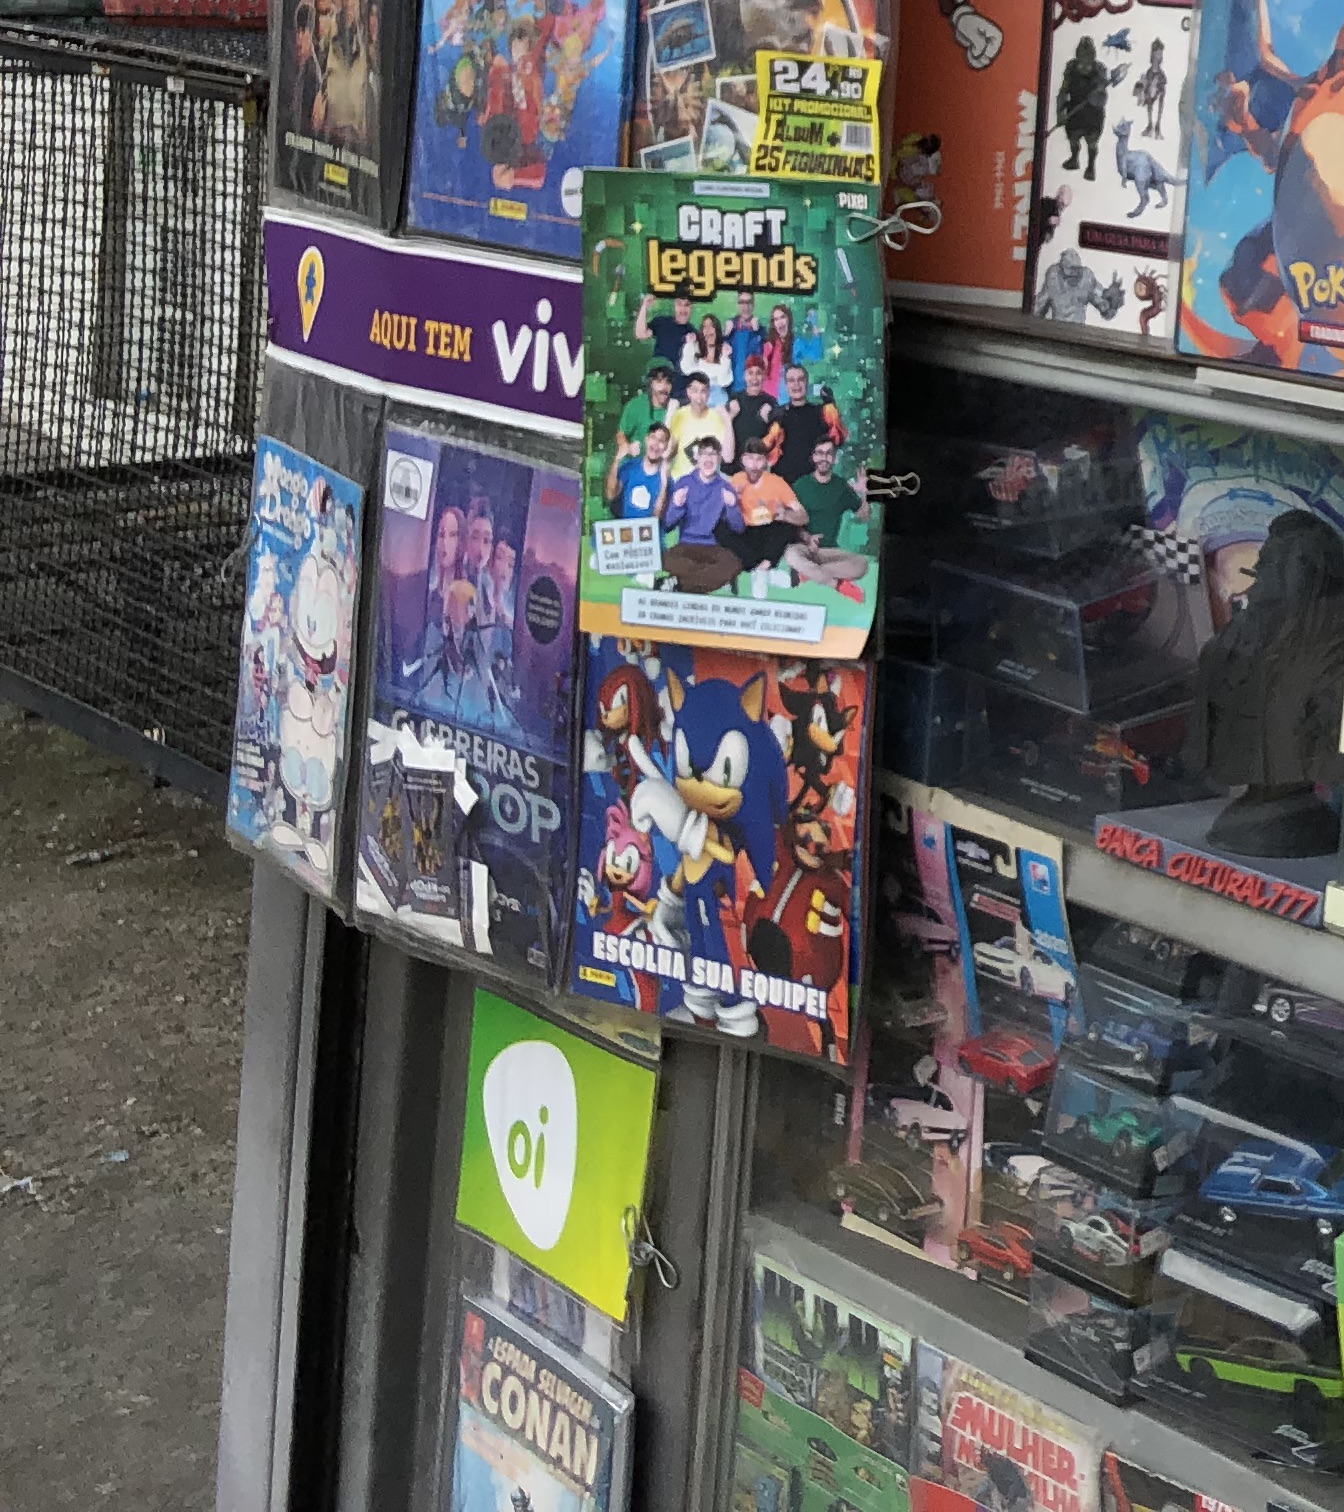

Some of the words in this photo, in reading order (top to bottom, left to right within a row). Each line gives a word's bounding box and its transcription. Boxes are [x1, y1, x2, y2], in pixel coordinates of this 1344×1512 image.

[756, 145, 782, 172] 25
[678, 208, 786, 247] CRAFT
[369, 309, 416, 350] AQUI
[424, 318, 471, 362] TEM
[1097, 826, 1161, 869] BANCA
[1168, 855, 1271, 909] CULTURAL
[1269, 883, 1318, 918] 777
[593, 931, 687, 983] ESCOLHA
[692, 957, 734, 994] SUA
[740, 972, 827, 1020] EQUIPE!
[507, 1104, 549, 1189] oi
[481, 1361, 599, 1485] CONAN
